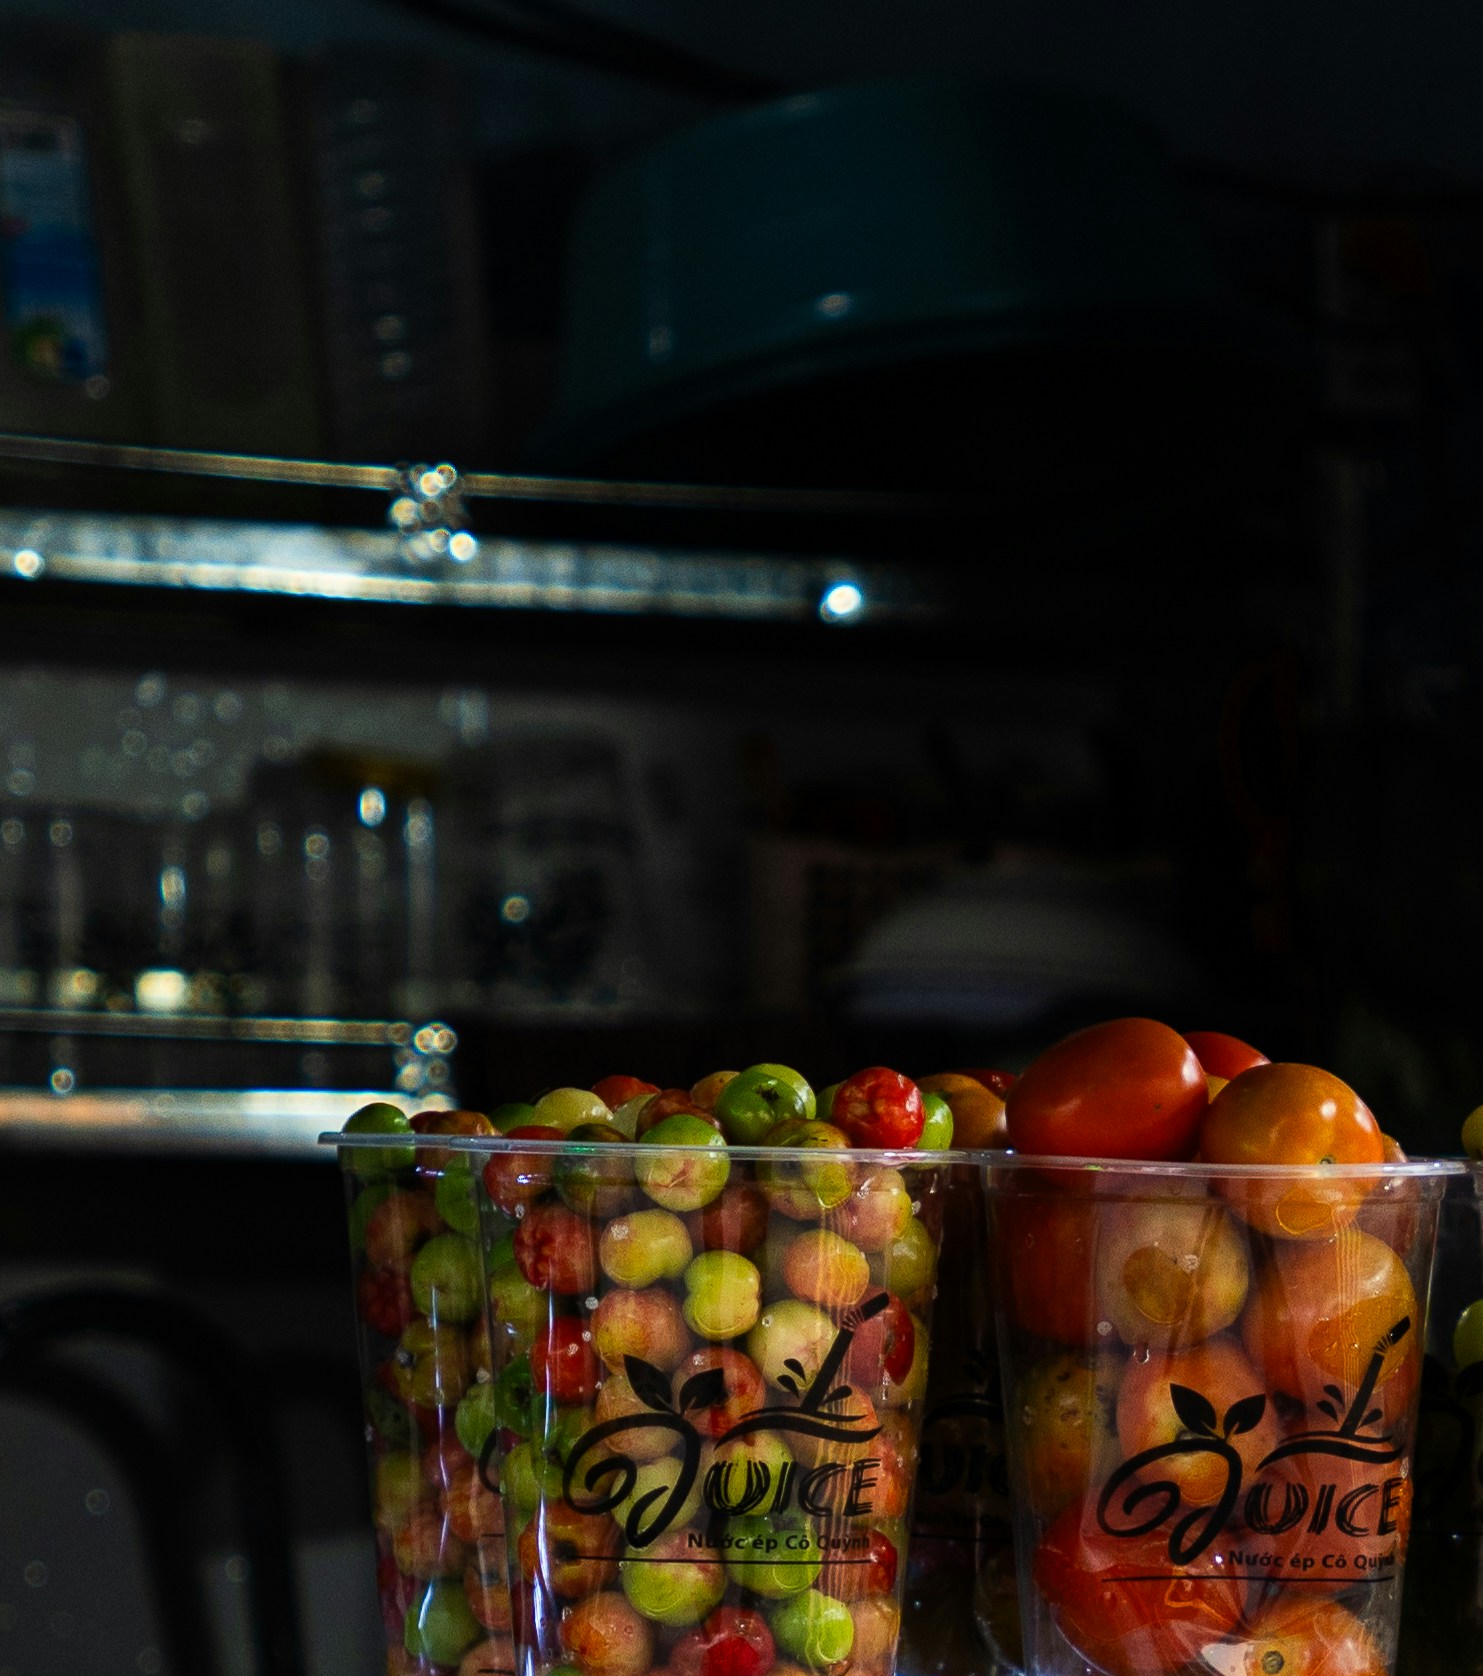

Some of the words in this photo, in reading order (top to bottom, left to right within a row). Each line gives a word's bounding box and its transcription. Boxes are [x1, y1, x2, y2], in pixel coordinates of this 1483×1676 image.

[562, 1412, 882, 1549] JUICE
[1096, 1437, 1404, 1567] JUICE
[752, 1533, 779, 1554] ép
[785, 1533, 810, 1549] Cô
[1228, 1550, 1283, 1569] Nước
[1289, 1552, 1316, 1572] ép
[1322, 1553, 1347, 1569] Cô
